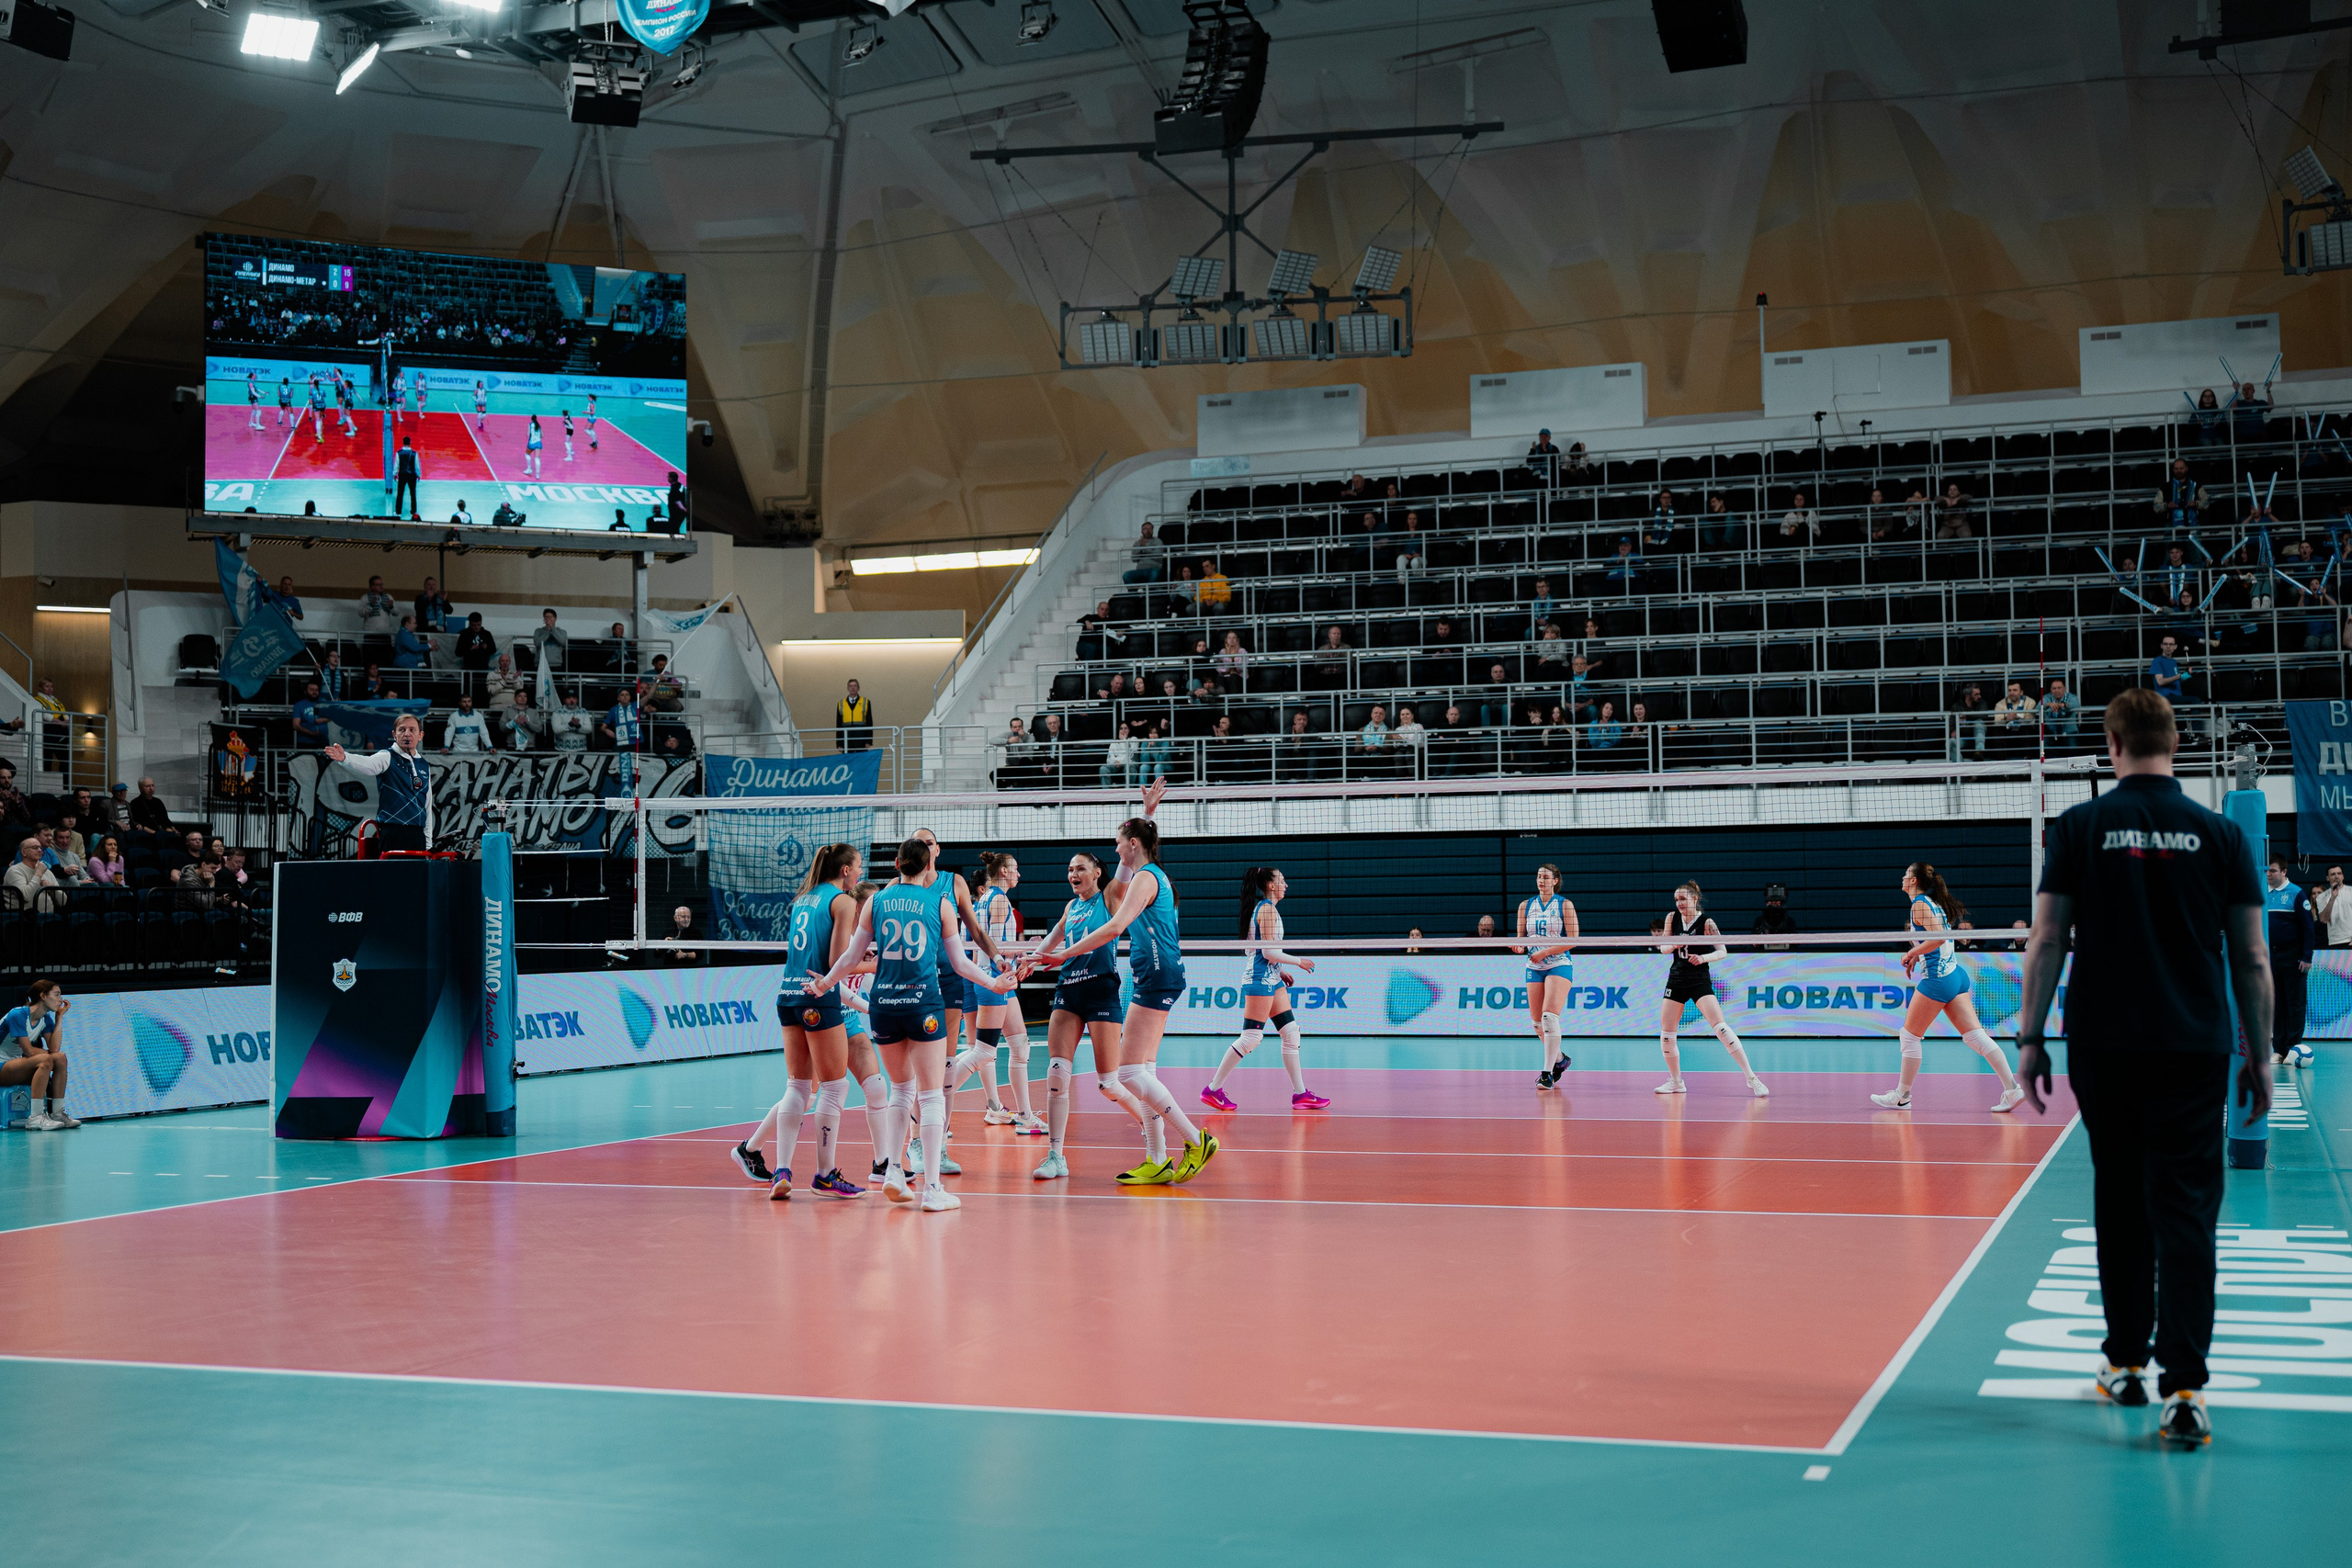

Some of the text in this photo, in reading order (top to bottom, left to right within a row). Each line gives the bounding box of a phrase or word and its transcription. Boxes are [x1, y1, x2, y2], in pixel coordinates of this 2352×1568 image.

[654, 26, 675, 37] 2017
[268, 263, 294, 272] ДИНАМО
[268, 275, 349, 289] ДИНАМО-МЕТАР 0 9
[222, 367, 271, 375] НОВАТЭК
[430, 377, 470, 385] НОВАТЭК
[726, 757, 853, 789] Динамо
[2102, 829, 2201, 852] ДИНАМО
[338, 912, 363, 922] ВФВ
[882, 898, 924, 915] ПОПОВА
[793, 911, 808, 951] 3
[1536, 920, 1547, 936] 16
[484, 897, 503, 993] ДИНАМО
[881, 919, 927, 962] 29
[1151, 939, 1160, 971] НОВАТЭК
[877, 996, 920, 1006] Северсталь
[1189, 987, 1349, 1009] НОТЭК
[1458, 987, 1629, 1010] НОВТЭК
[484, 980, 499, 1047] Москва
[664, 1000, 758, 1029] НОВАТЭК
